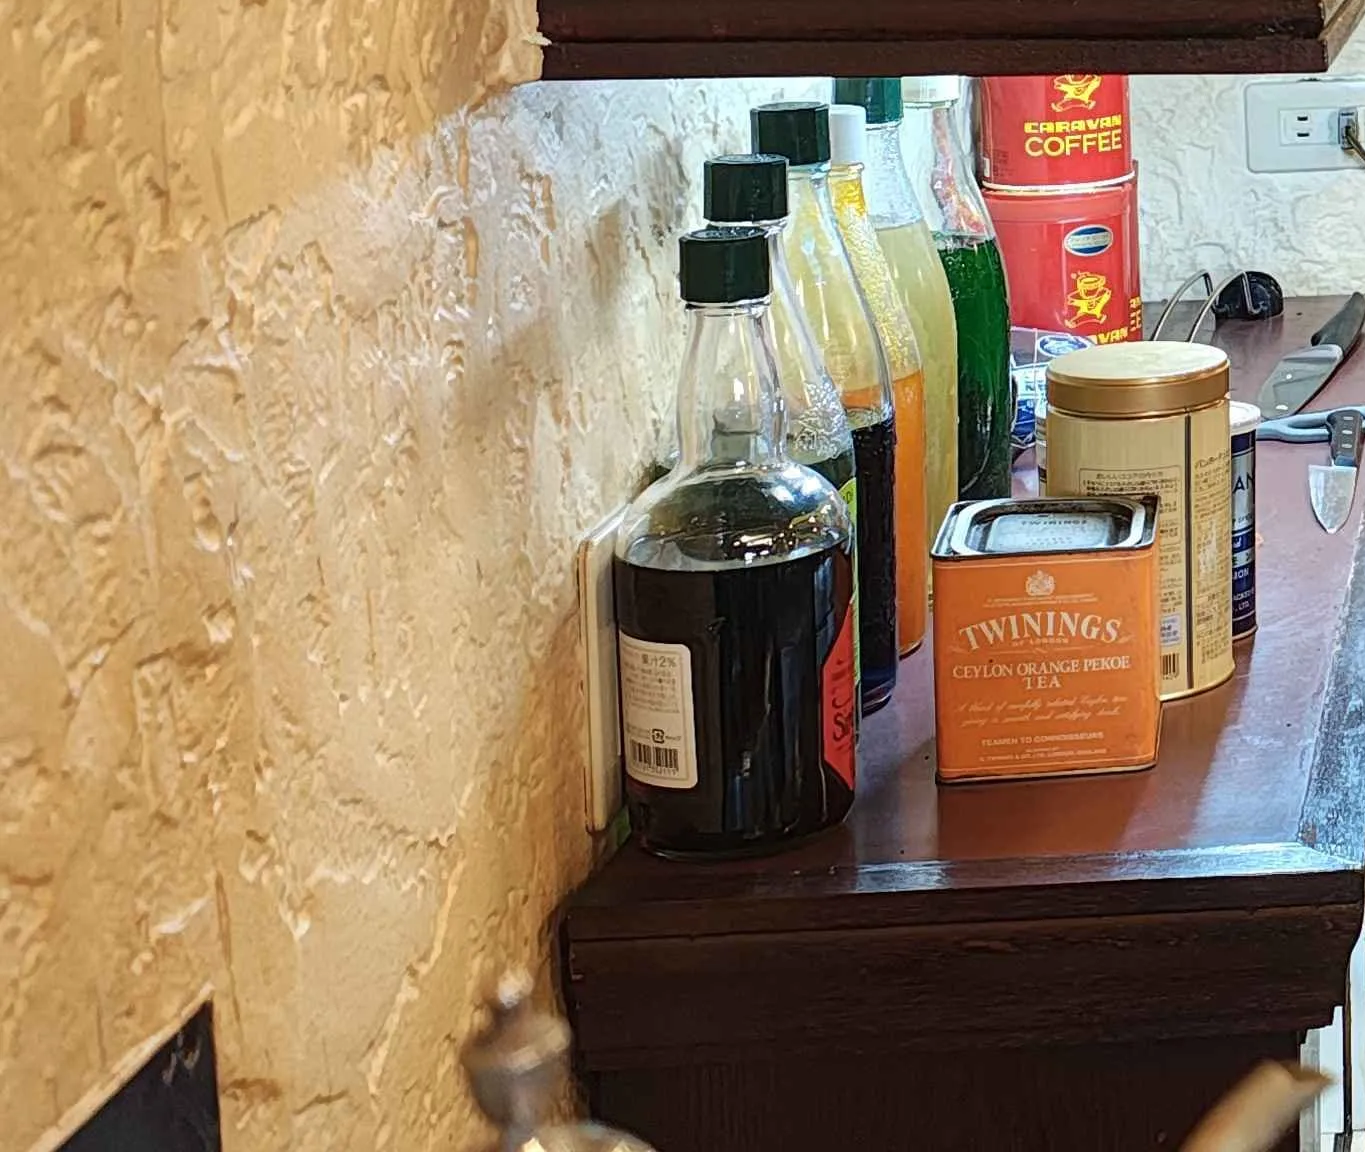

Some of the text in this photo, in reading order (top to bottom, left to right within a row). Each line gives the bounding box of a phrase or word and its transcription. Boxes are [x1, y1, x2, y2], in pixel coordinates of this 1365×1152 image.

[1024, 114, 1122, 133] CARAVAN
[1025, 129, 1122, 157] COFFEE
[959, 612, 1122, 650] TWININGS
[952, 655, 1131, 679] CEYLON ORANGE PEKOE
[1023, 675, 1062, 690] TEA
